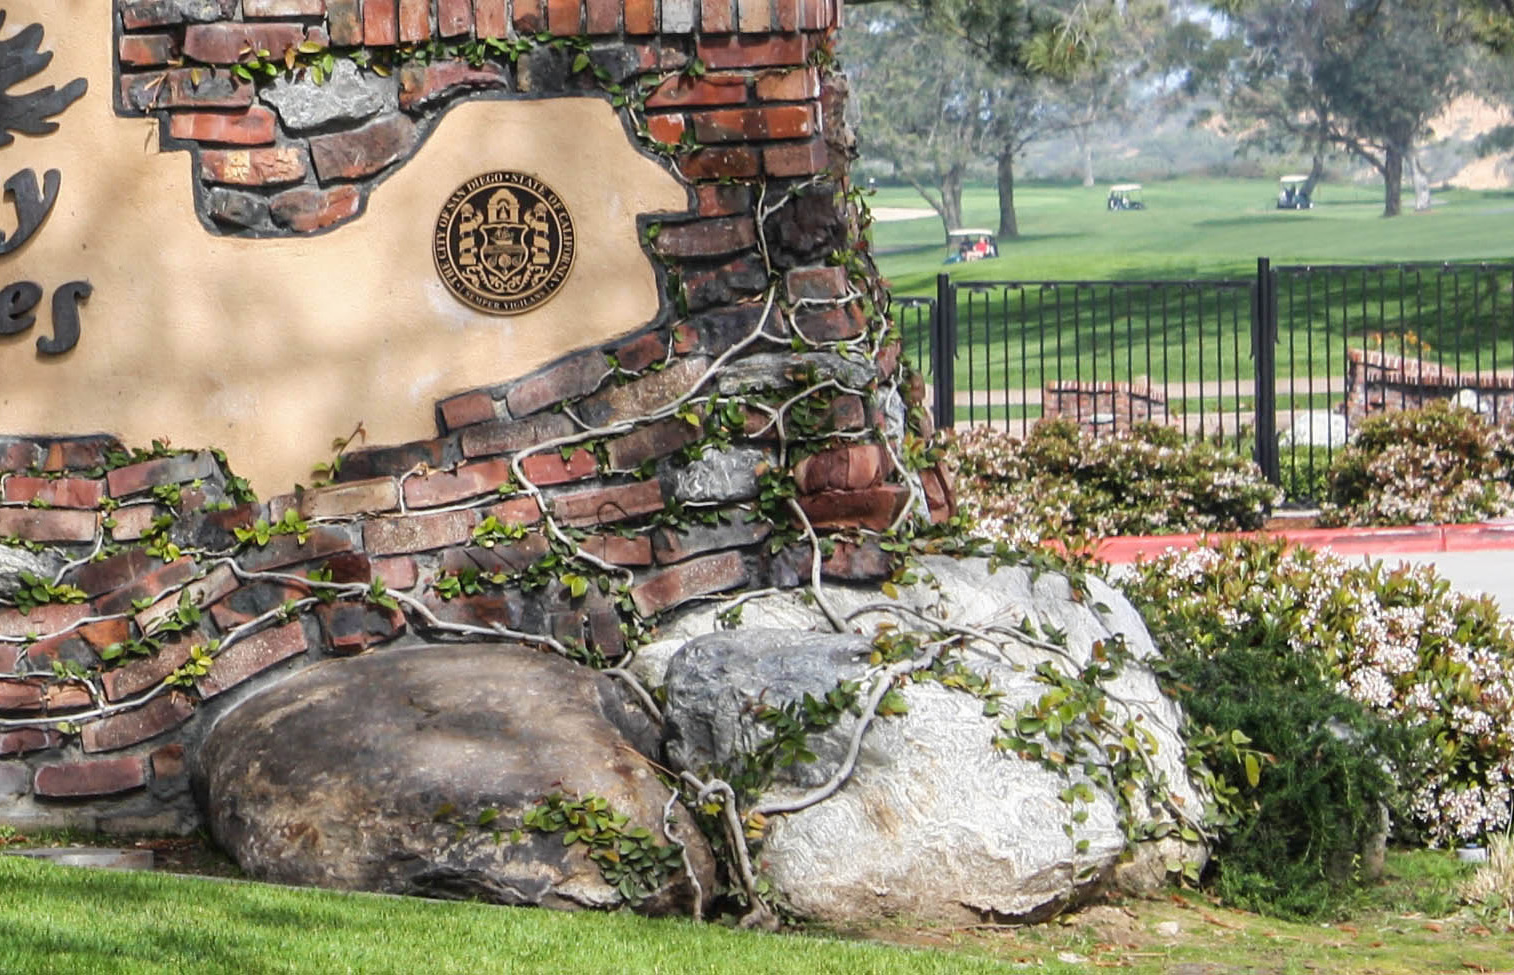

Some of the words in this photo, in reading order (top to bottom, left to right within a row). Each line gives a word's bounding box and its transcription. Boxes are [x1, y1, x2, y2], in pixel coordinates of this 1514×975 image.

[466, 172, 503, 192] DIEGO
[510, 174, 546, 195] STATE
[446, 190, 466, 211] SAN
[548, 195, 563, 213] OF
[438, 211, 451, 228] OF
[436, 231, 447, 260] CITY
[555, 212, 573, 283] CALIFORNIA
[440, 260, 458, 284] THE
